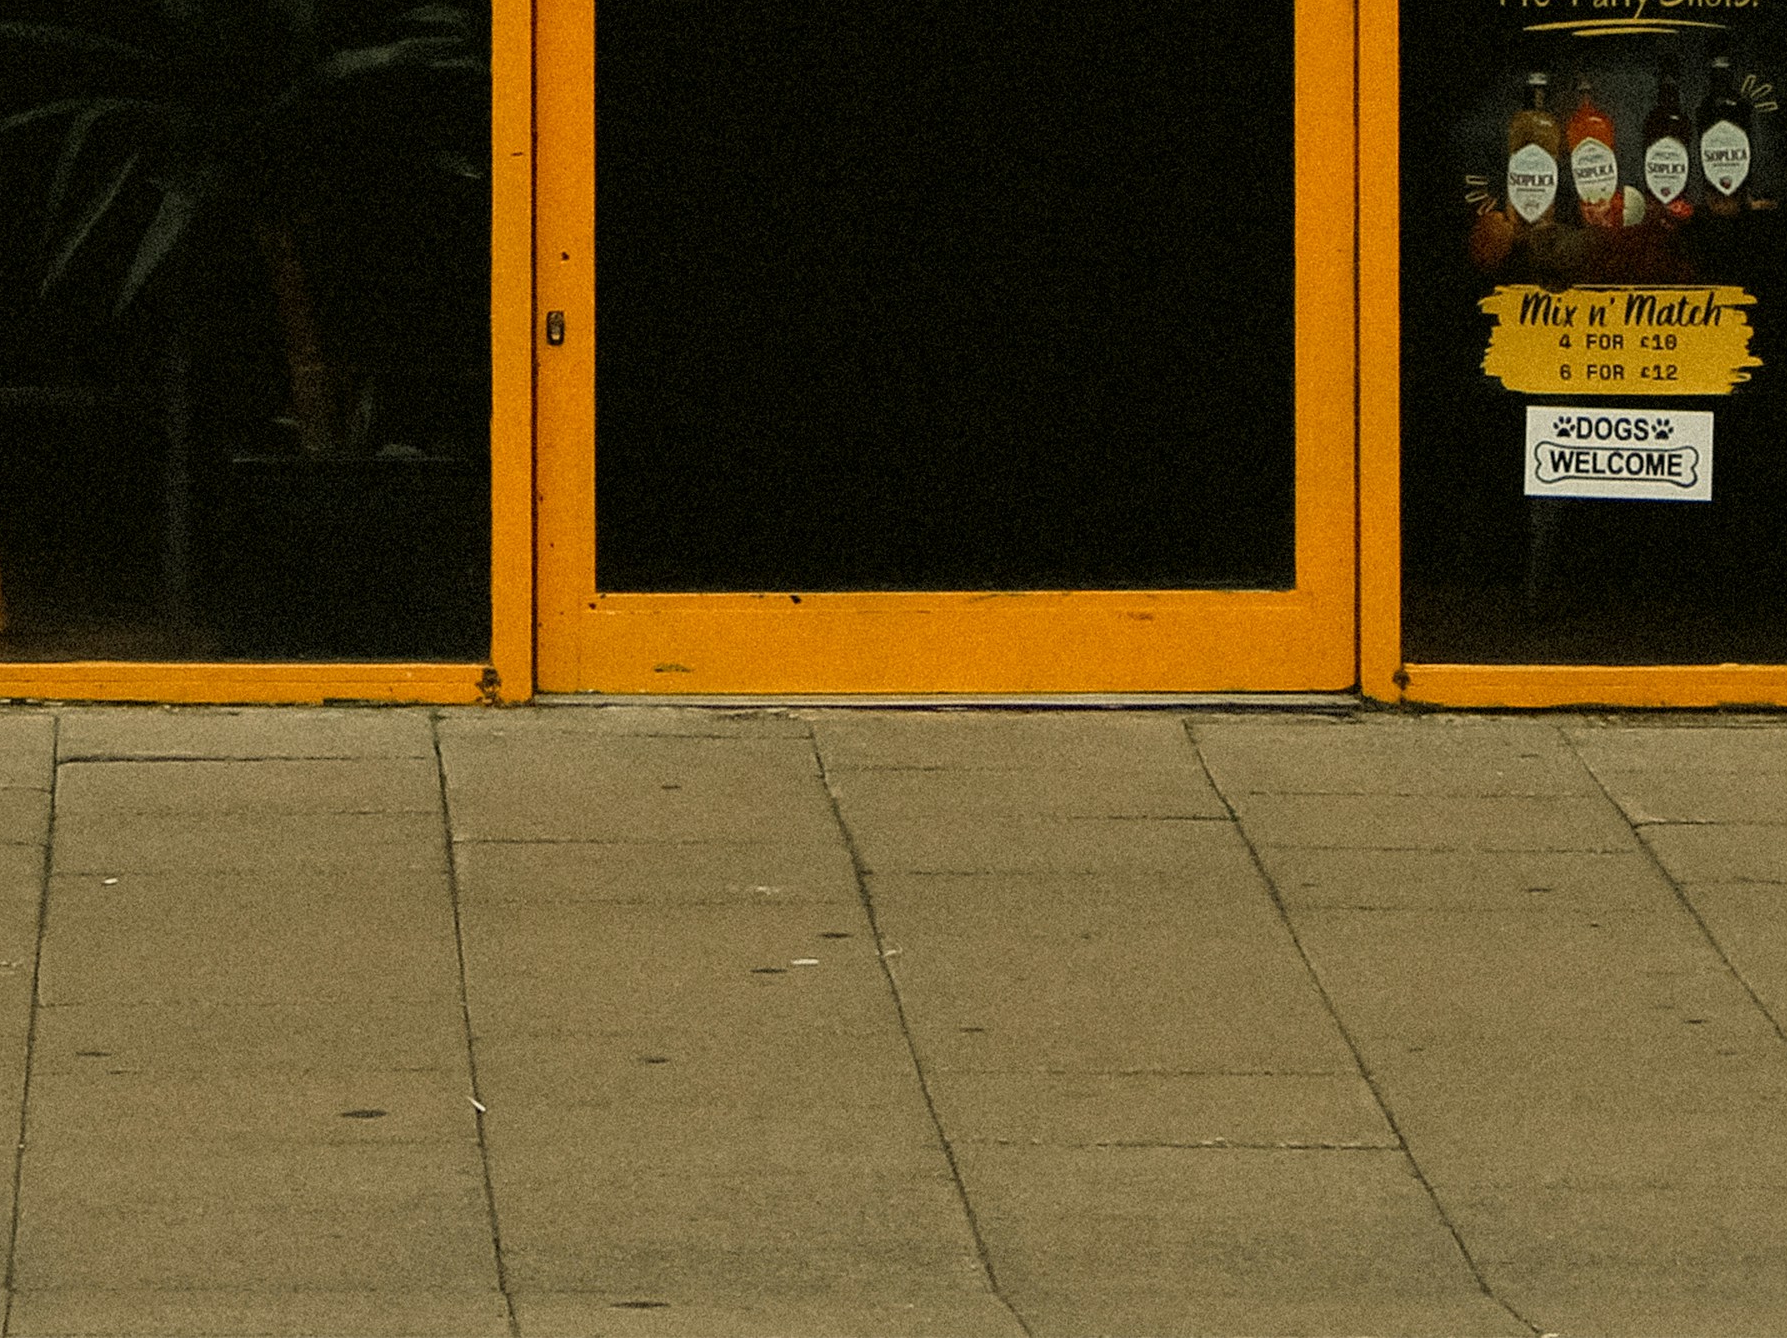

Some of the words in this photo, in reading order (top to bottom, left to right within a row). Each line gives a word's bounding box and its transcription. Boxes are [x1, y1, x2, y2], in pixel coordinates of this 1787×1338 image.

[1519, 291, 1578, 327] Mix
[1624, 290, 1723, 327] Match
[1558, 334, 1572, 350] 4
[1585, 334, 1625, 350] FOR
[1559, 364, 1572, 380] 6
[1585, 364, 1625, 380] FOR
[1640, 364, 1678, 380] £12
[1576, 417, 1650, 442] DOGS
[1549, 450, 1683, 477] WELCOME
